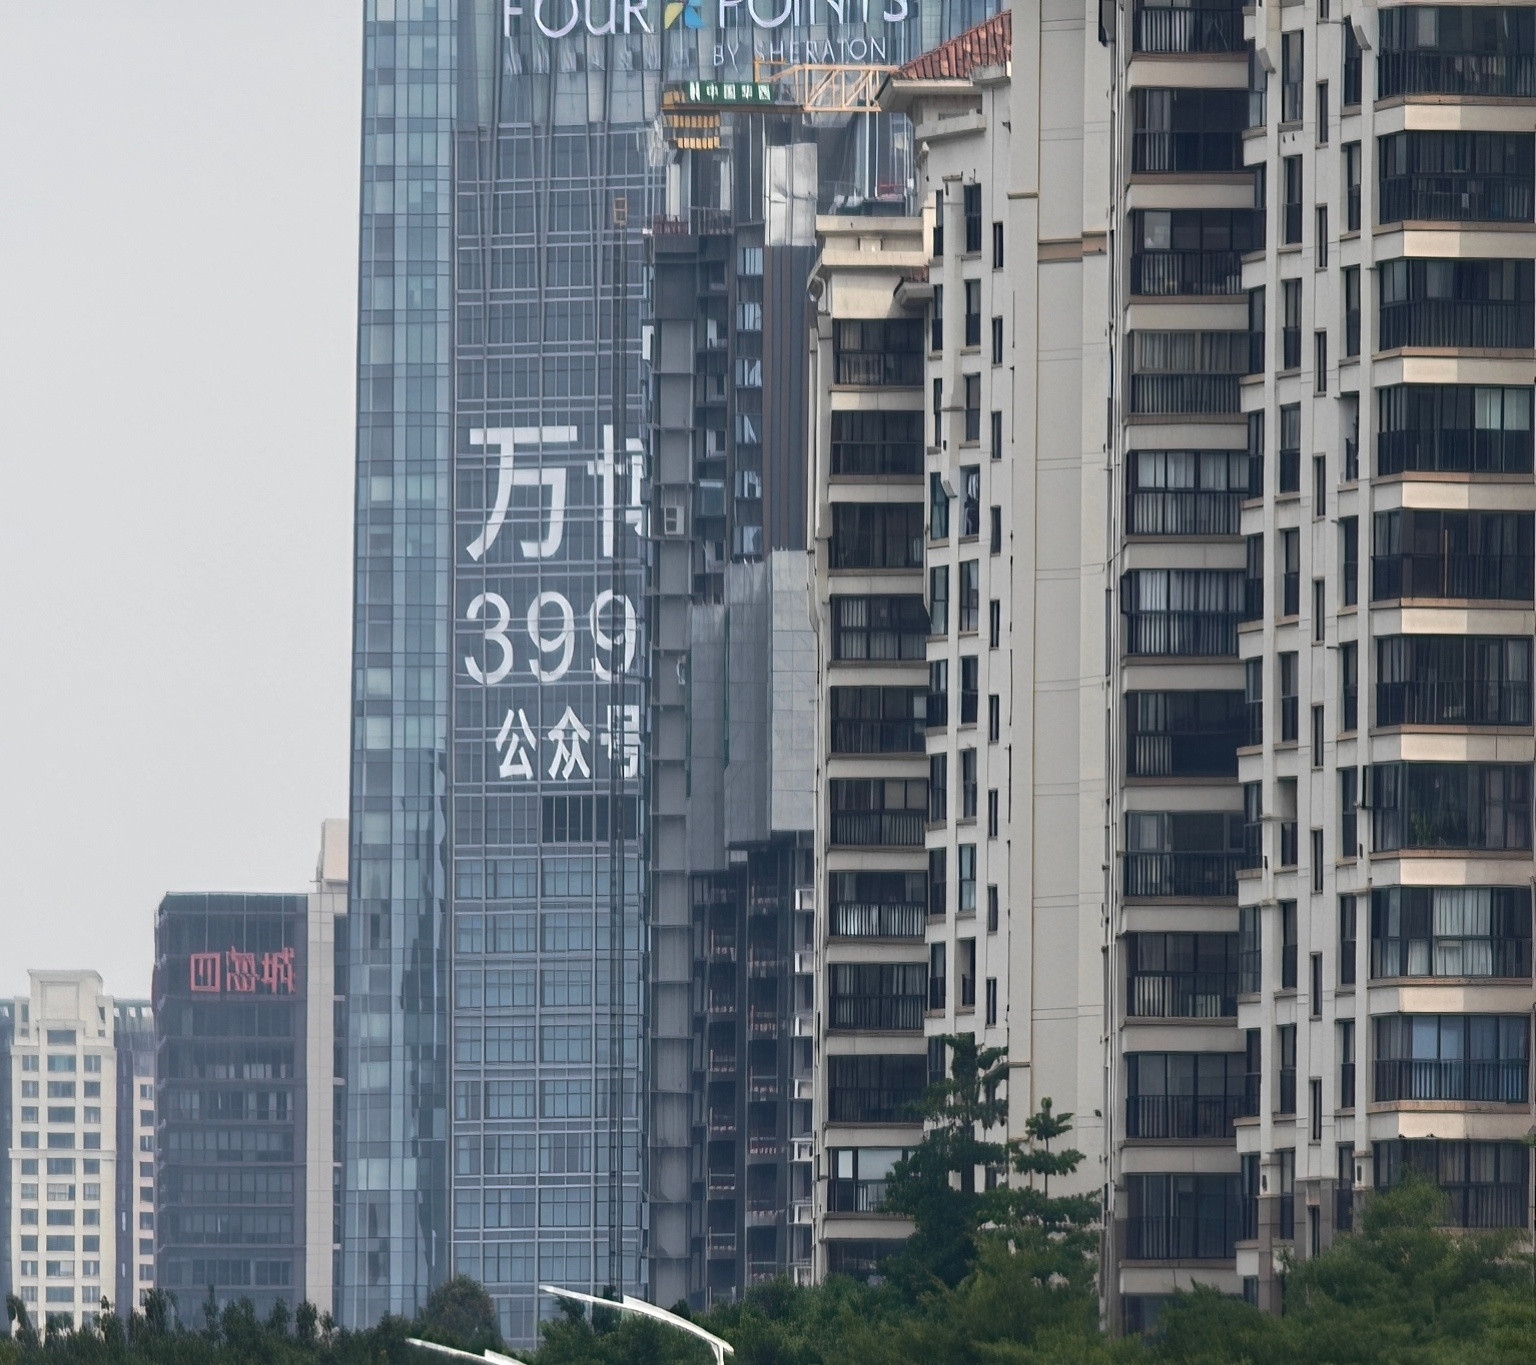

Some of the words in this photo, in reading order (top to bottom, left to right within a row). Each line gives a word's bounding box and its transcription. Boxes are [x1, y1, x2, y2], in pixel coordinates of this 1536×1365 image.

[464, 588, 637, 685] 399
[496, 705, 641, 779] 公众号
